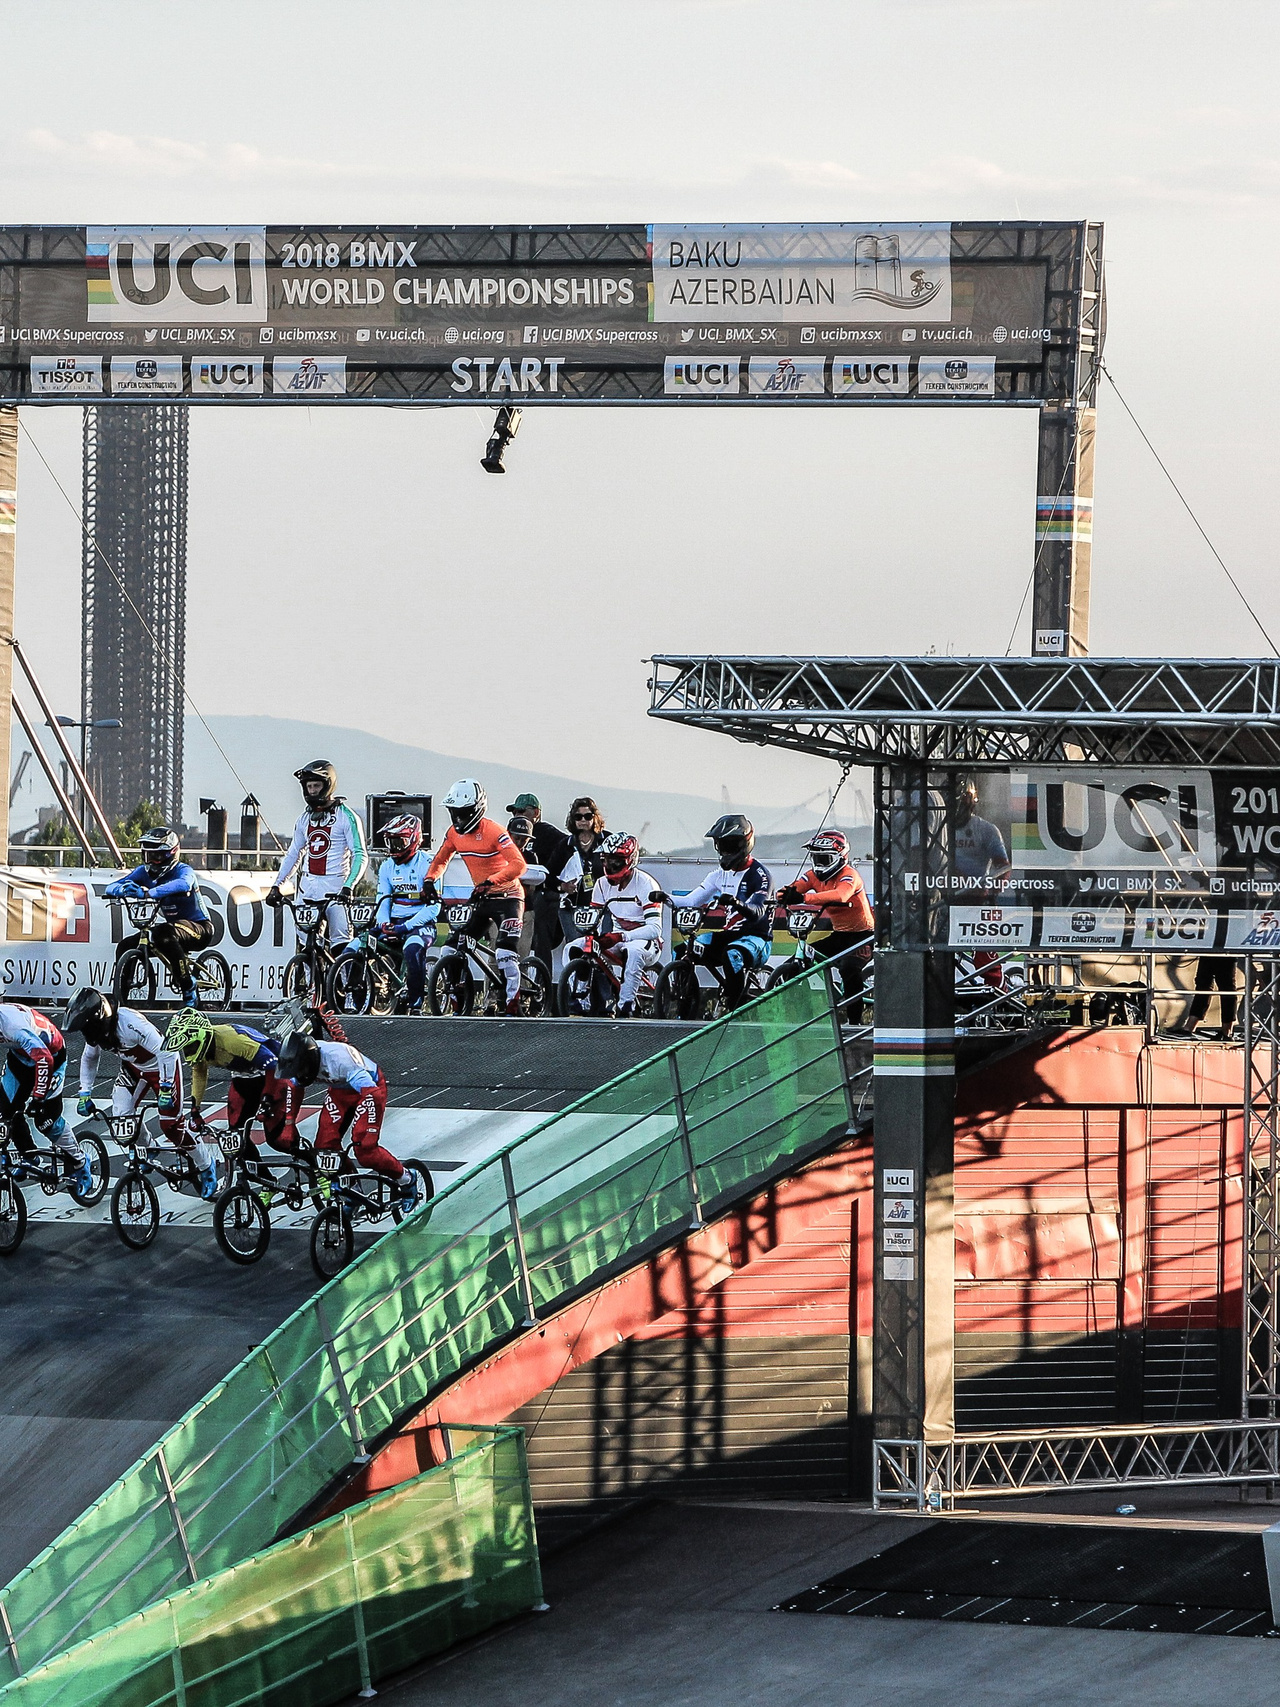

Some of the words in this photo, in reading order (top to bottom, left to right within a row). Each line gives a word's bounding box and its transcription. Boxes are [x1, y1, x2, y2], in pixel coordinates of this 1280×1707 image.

[282, 242, 339, 268] 2018
[350, 241, 417, 267] BMX
[669, 241, 741, 268] BAKU
[117, 242, 254, 305] UCI
[282, 278, 385, 304] WORLD
[393, 278, 634, 305] CHAMPIONSHIPS
[669, 278, 835, 305] AZERBAIJAN
[11, 328, 31, 341] UCI
[33, 328, 61, 341] BMX
[63, 328, 124, 344] Supercross
[161, 328, 236, 344] UCI_BMX_SX
[279, 328, 337, 341] ucibmxsx
[375, 328, 425, 341] tv.uci.ch
[462, 328, 504, 344] uci.org
[542, 328, 564, 341] UCI
[565, 328, 594, 341] BMX
[595, 328, 658, 344] Supercross
[698, 328, 777, 344] UCI_BMX_SX
[821, 327, 882, 340] ucibmxsx
[922, 327, 973, 340] tv.uci.ch
[1011, 326, 1051, 342] uci.org
[38, 371, 95, 383] TISSOT
[211, 364, 254, 385] UCI
[451, 357, 566, 393] START
[684, 364, 730, 385] UCI
[853, 364, 899, 384] UCI
[1042, 636, 1060, 645] UCI
[1046, 783, 1200, 853] UCI
[926, 876, 948, 889] UCI
[952, 876, 982, 889] BMX
[985, 875, 1055, 892] Supercross
[133, 907, 147, 919] 74
[298, 910, 313, 922] 48
[353, 908, 370, 921] 102
[451, 909, 468, 922] 921
[575, 911, 593, 924] 697
[679, 912, 697, 925] 164
[793, 915, 807, 927] 42
[958, 923, 1024, 937] TISSOT
[1157, 917, 1205, 940] UCI
[1048, 935, 1070, 943] TEKFEN
[1071, 936, 1116, 944] CONSTRUCTION
[3, 959, 76, 986] SWISS
[36, 1057, 48, 1095] RUSSIA
[114, 1122, 134, 1136] 715
[221, 1136, 239, 1150] 288
[320, 1155, 336, 1169] 707
[891, 1176, 909, 1185] UCI
